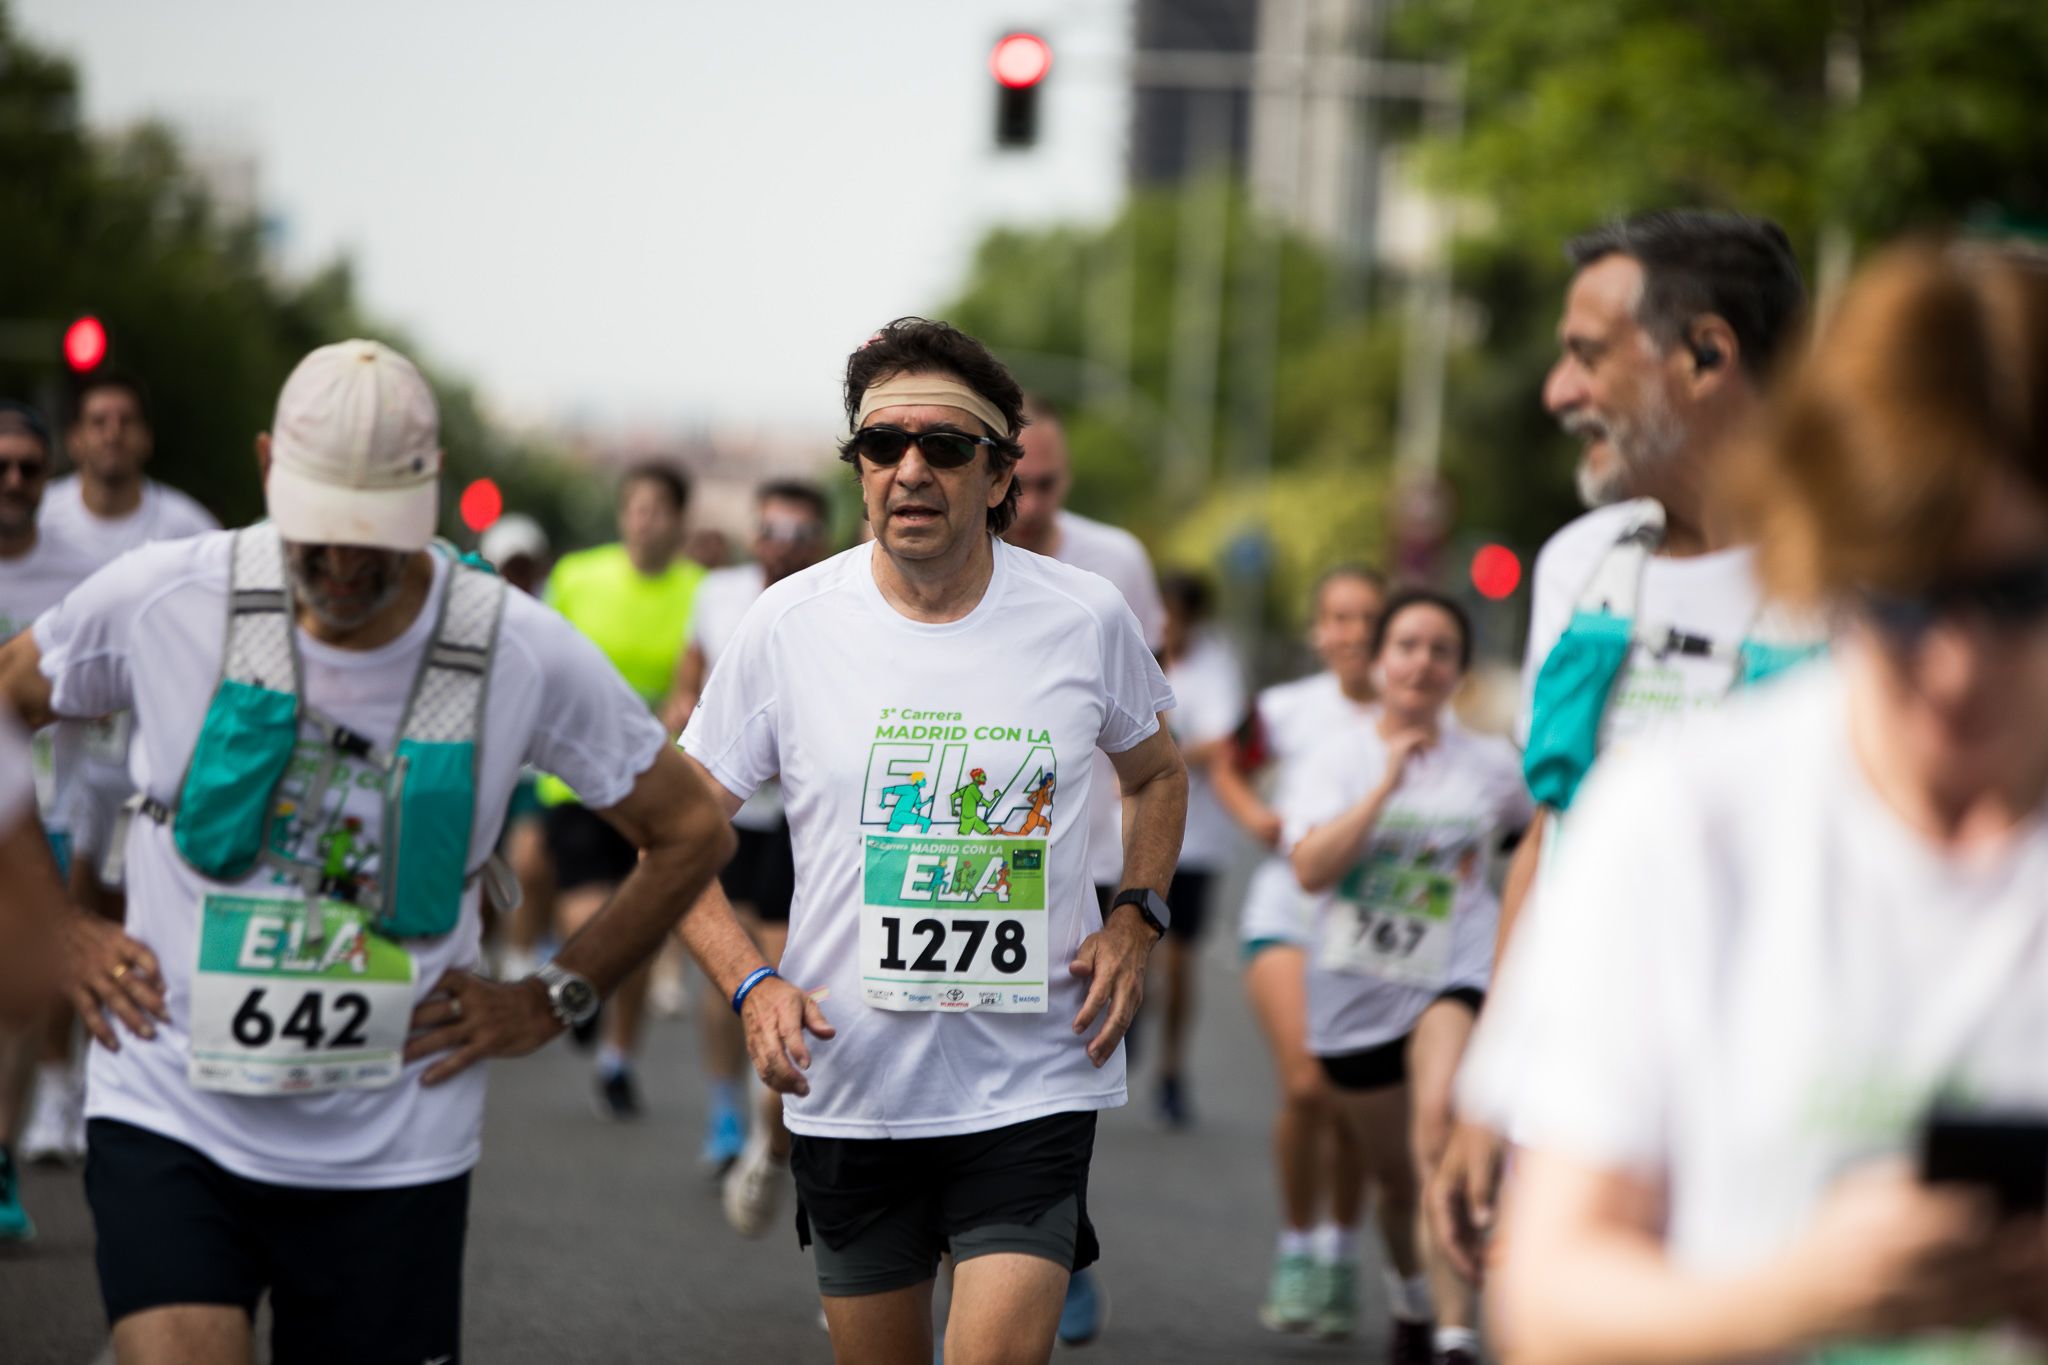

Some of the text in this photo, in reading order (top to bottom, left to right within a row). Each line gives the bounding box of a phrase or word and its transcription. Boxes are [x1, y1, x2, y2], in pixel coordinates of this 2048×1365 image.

[875, 725, 1051, 744] MADRID CON LA
[901, 708, 963, 721] Carrera
[860, 743, 1057, 825] ELA
[910, 842, 959, 855] MADRID
[962, 844, 987, 855] CON
[989, 845, 1003, 855] LA
[899, 854, 1010, 904] ELA
[238, 914, 367, 974] ELA
[880, 916, 1028, 975] 1278
[1355, 902, 1428, 959] 767
[231, 987, 371, 1049] 642
